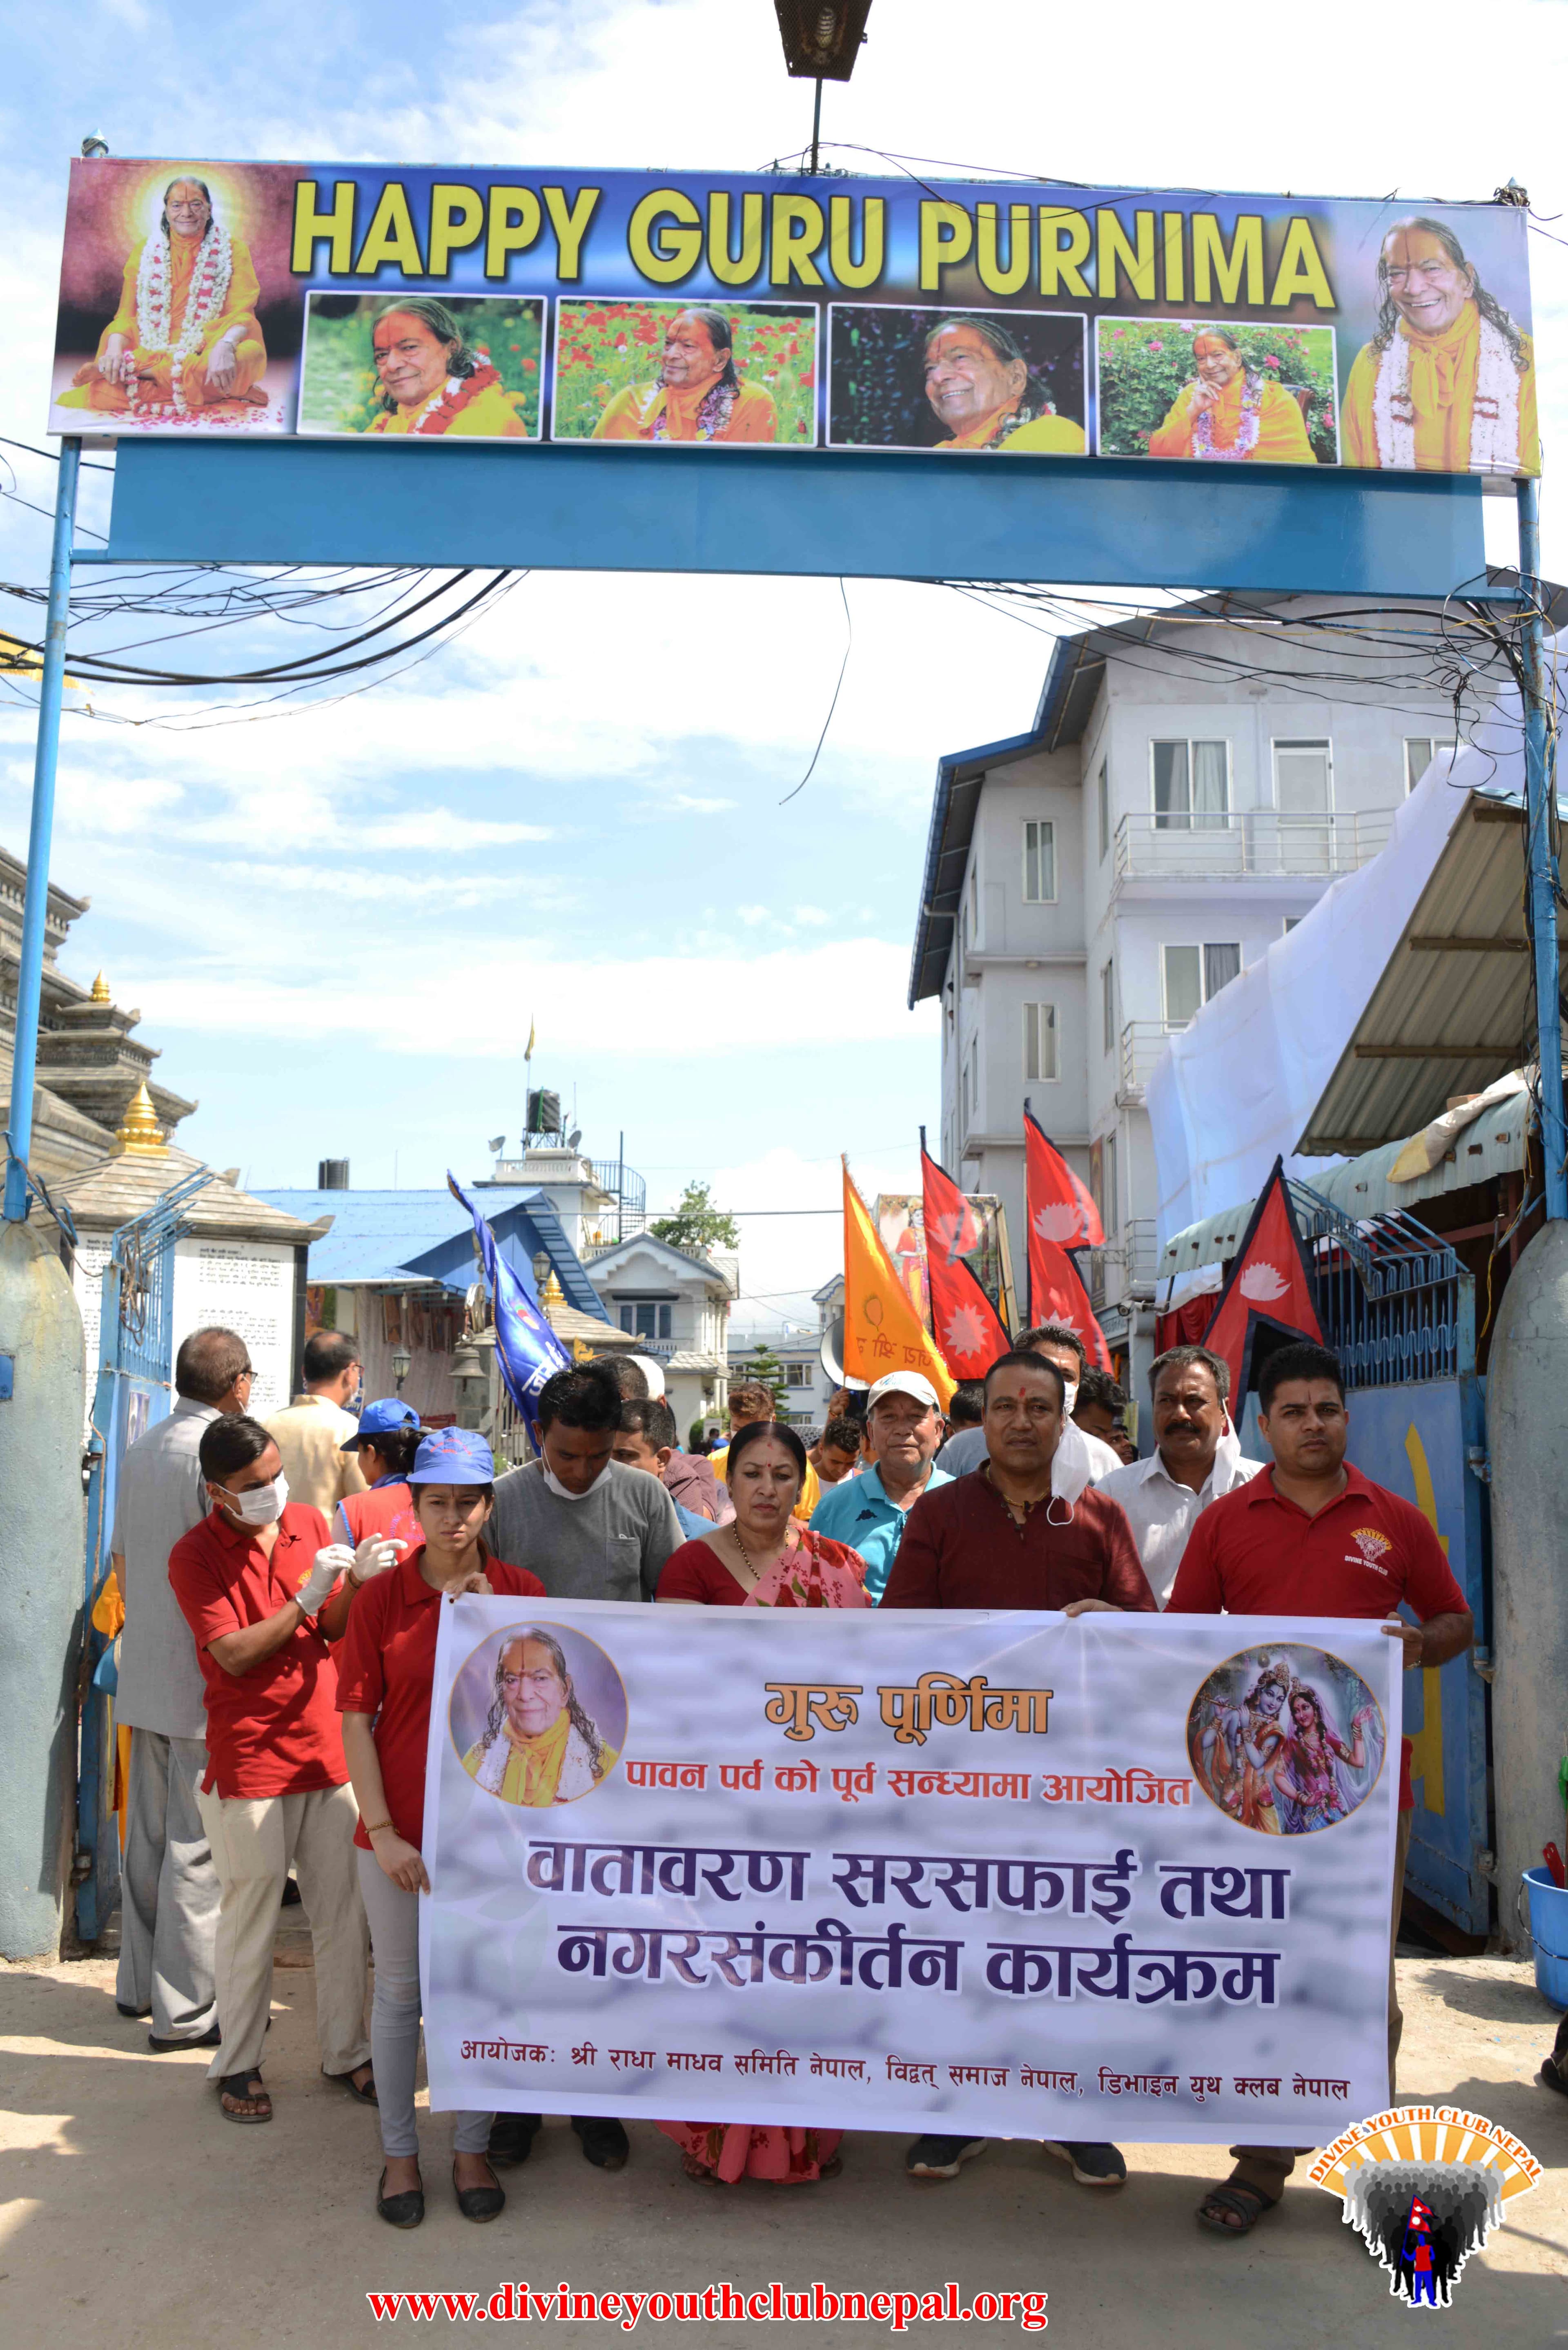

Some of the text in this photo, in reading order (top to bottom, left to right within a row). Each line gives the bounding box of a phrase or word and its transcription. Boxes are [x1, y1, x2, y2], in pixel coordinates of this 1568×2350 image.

[292, 181, 1336, 308] HAPPY GURU PURNIMA
[1345, 1555, 1363, 1565] DIVINE
[1363, 1560, 1379, 1571] YOUTH
[764, 1671, 1054, 1746] गुरू पूर्णिमा
[626, 1759, 1192, 1806] पावन पर्व को पूर्व सन्ध्यामा आयोजित
[527, 1841, 1291, 1925] वातावरण सरसफाई तथा
[557, 1918, 1281, 2004] नगरसंकीर्तन कार्यक्रम
[571, 2041, 598, 2066] श्री
[608, 2049, 657, 2071] राधा
[666, 2052, 724, 2073] माधव
[734, 2049, 800, 2076] समिति
[809, 2052, 871, 2084] नेपाल,
[948, 2065, 1011, 2087] समाज
[1020, 2063, 1083, 2096] नेपाल,
[1097, 2066, 1180, 2098] डिभाइन
[1189, 2076, 1223, 2103] युथ
[1233, 2077, 1282, 2098] क्लब
[1292, 2072, 1351, 2100] नेपाल
